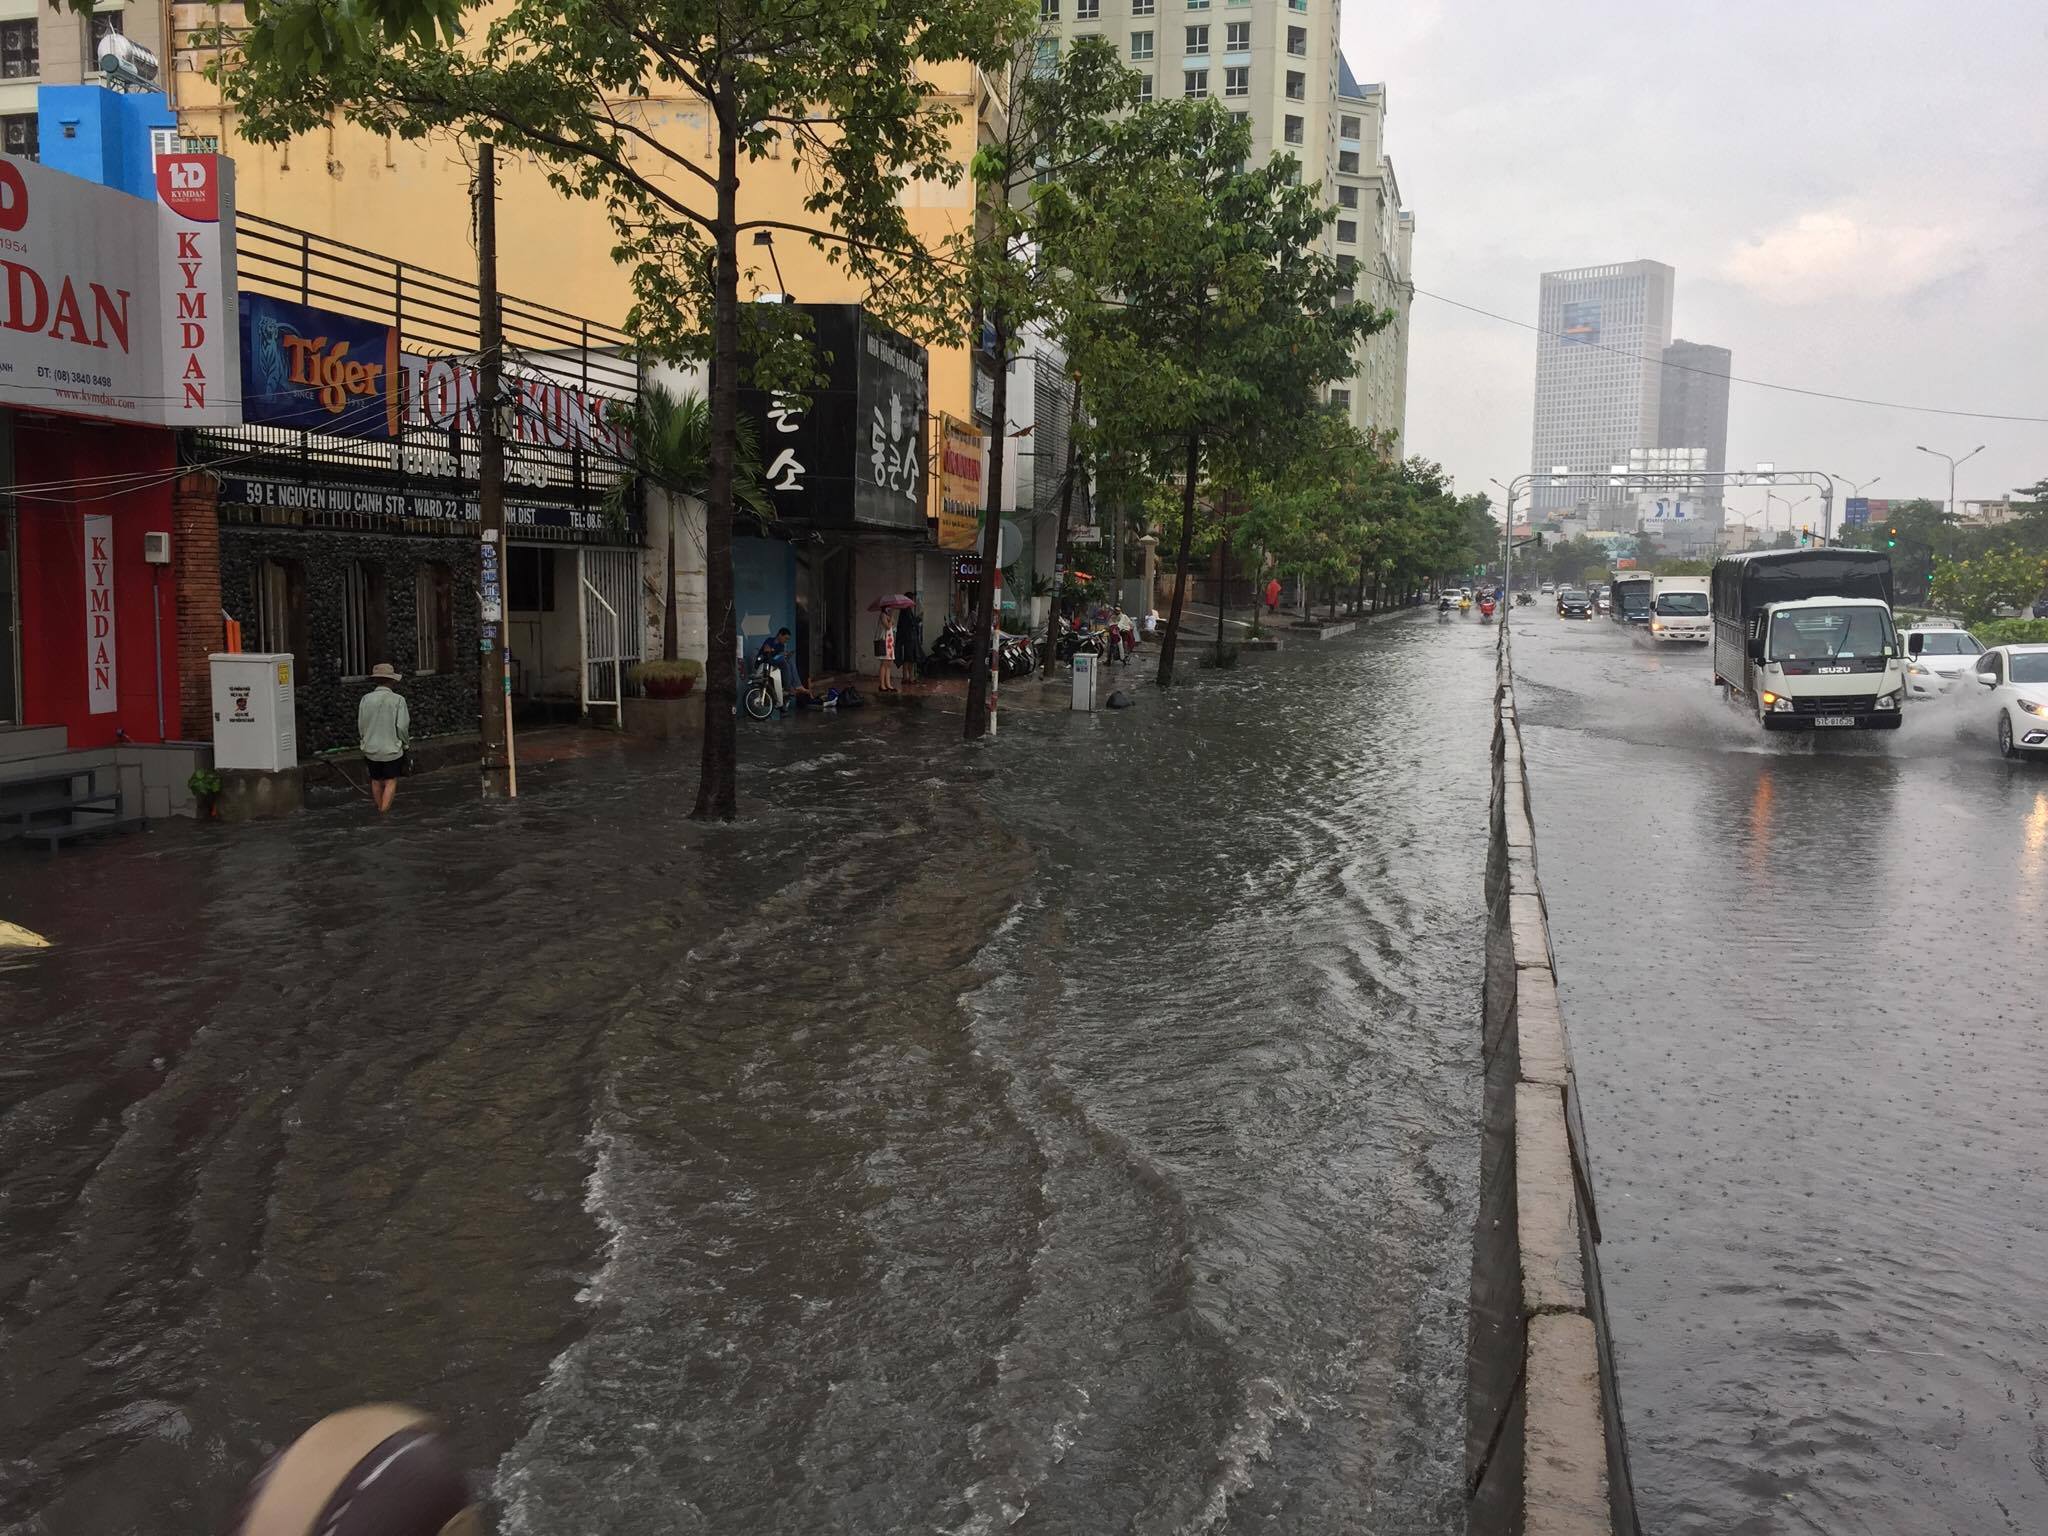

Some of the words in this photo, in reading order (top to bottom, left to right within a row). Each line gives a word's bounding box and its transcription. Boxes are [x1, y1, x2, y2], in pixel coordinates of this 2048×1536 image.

[171, 190, 206, 198] KYMDAN
[0, 238, 27, 254] 1954
[0, 258, 131, 354] DAN
[176, 232, 208, 410] KYMDAN
[37, 366, 52, 378] ĐT:
[53, 369, 70, 384] (08)
[71, 372, 91, 385] 3840
[92, 374, 112, 388] 8498
[282, 334, 384, 415] Tiger
[55, 387, 136, 410] www.kymdan.com
[293, 391, 315, 400] SINCE
[389, 447, 459, 478] TONG
[519, 465, 549, 489] SO
[246, 483, 263, 504] 59
[266, 484, 275, 504] E
[278, 485, 326, 509] NGUYEN
[329, 491, 351, 510] HUU
[354, 492, 383, 513] CANH
[385, 496, 405, 515] STR
[414, 498, 443, 517] WARD
[445, 501, 457, 519] 22
[465, 503, 481, 521] BIN
[518, 508, 536, 525] DIST
[570, 512, 586, 528] TEL:
[90, 536, 110, 691] KYMDAN
[1818, 666, 1851, 674] ISUZU
